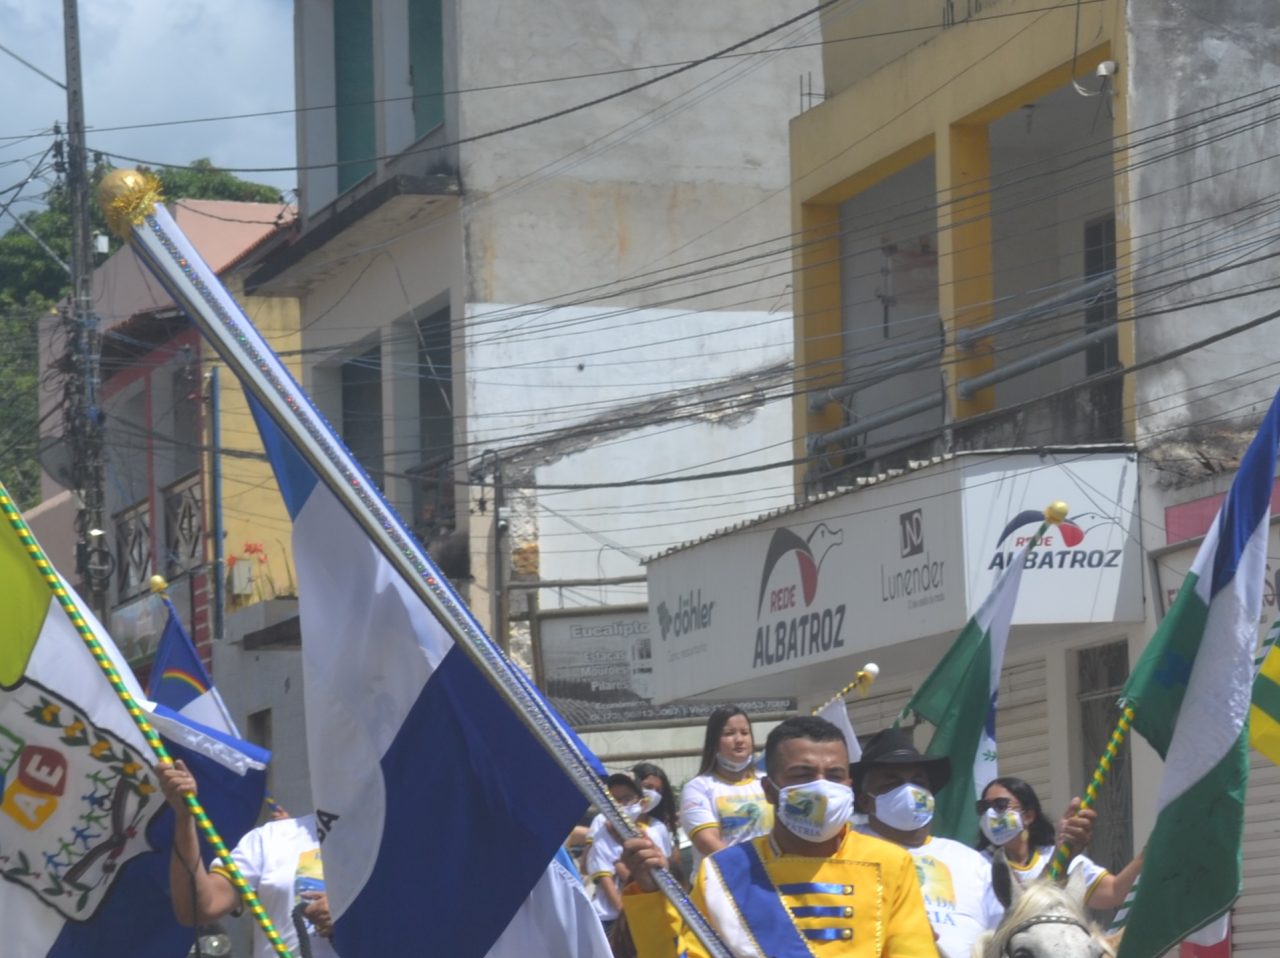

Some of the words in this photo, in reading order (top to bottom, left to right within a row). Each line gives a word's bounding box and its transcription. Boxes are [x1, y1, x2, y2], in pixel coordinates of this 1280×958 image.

[769, 584, 797, 613] REDE
[880, 552, 945, 602] Lunender
[673, 588, 715, 638] döhler
[752, 603, 846, 669] ALBATROZ
